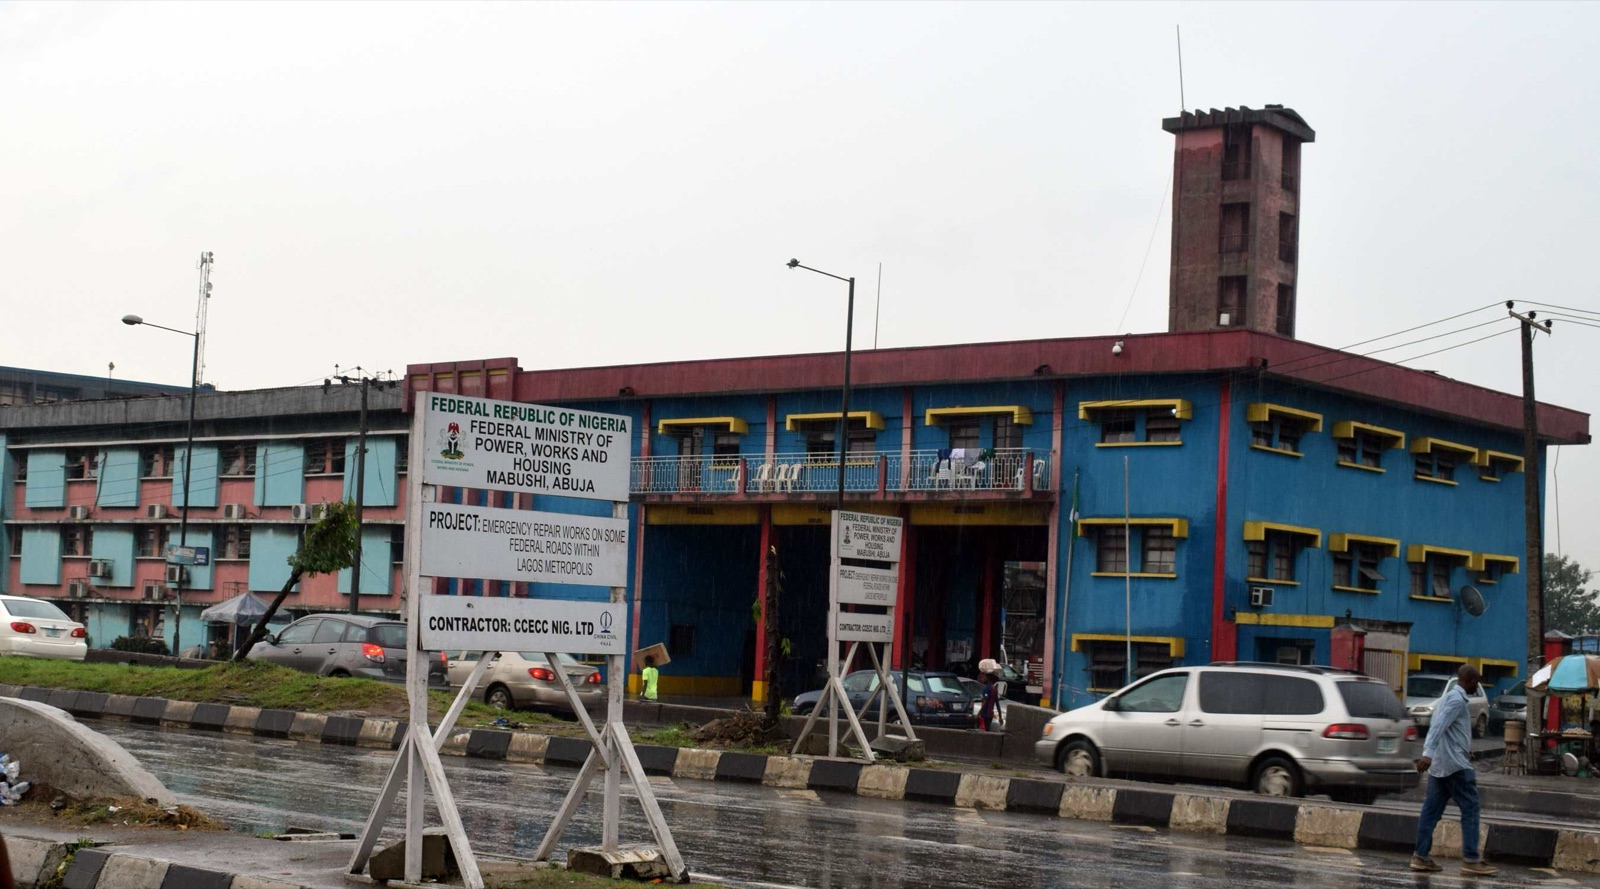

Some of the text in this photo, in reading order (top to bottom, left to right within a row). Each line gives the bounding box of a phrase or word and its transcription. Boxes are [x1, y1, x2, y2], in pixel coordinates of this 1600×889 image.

[432, 396, 627, 433] FEDERAL REPUBLIC OF NIGERIA
[470, 420, 613, 447] FEDERAL MINISTRY OF
[475, 437, 608, 463] POWER, WORKS AND
[514, 458, 571, 475] HOUSING
[486, 470, 595, 492] MABUSHI, ABUJA
[429, 511, 626, 543] PROJECT: EMERGENCY REPAIR WORKS ON SOME
[840, 513, 859, 522] FEDERAL
[860, 515, 880, 524] REPUBLIC
[852, 524, 871, 532] FEDERAL
[873, 526, 890, 534] MINISTRY
[510, 538, 600, 557] FEDERAL ROADS WITHIN
[865, 542, 883, 550] HOUSING
[517, 558, 593, 576] LAGOS METROPOLIS
[429, 616, 594, 635] CONTRACTOR: CCECC NIG. LTD
